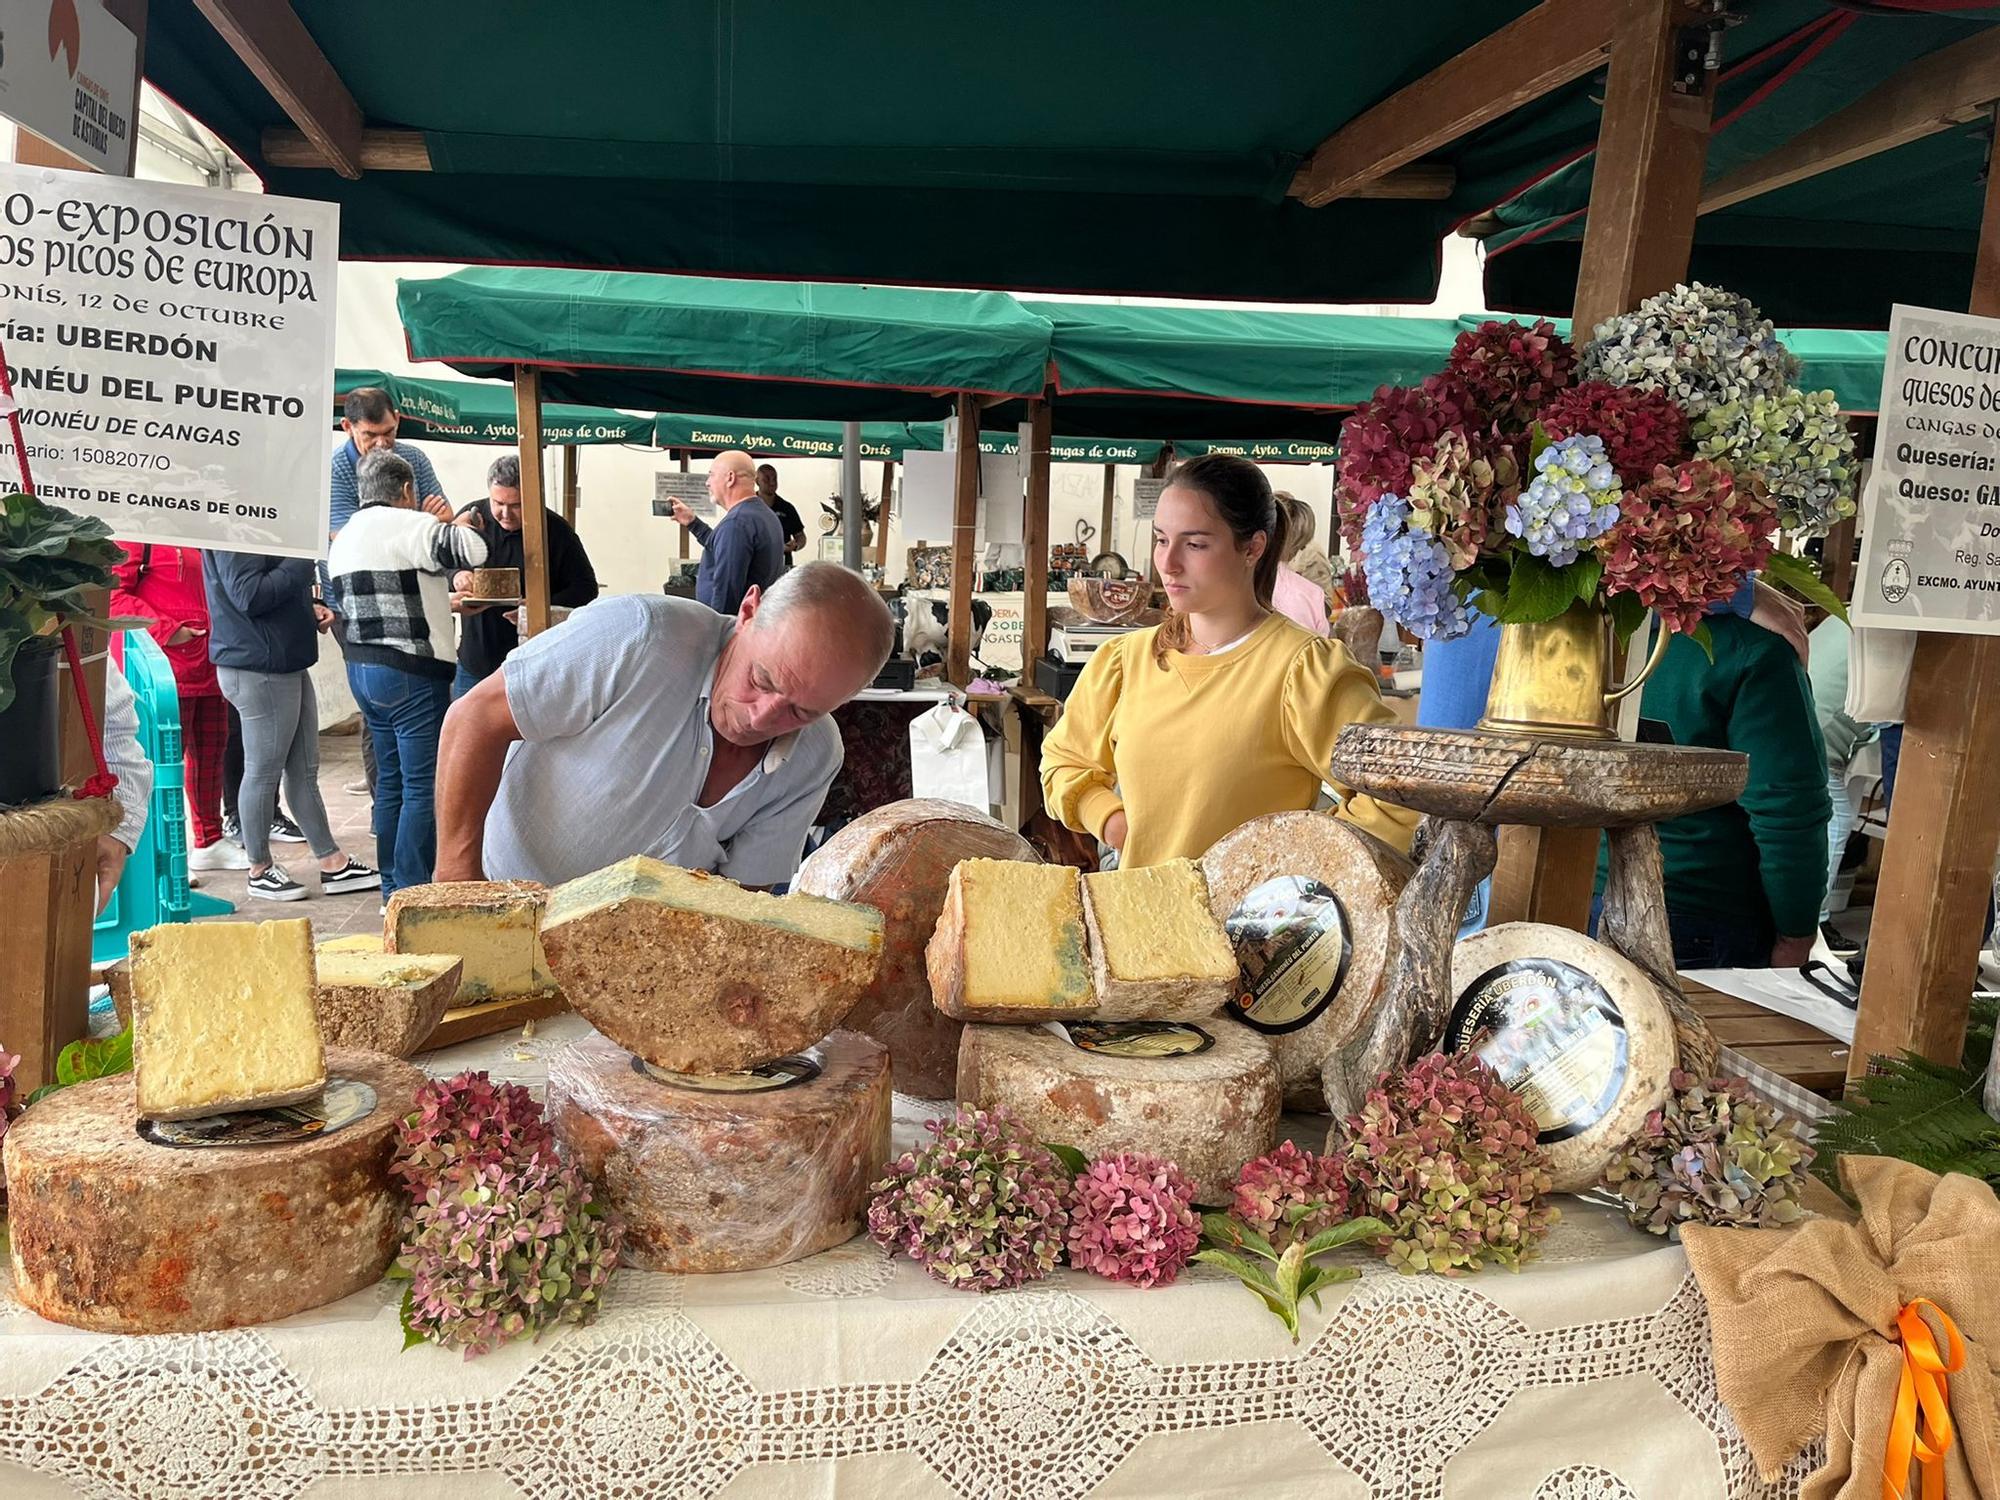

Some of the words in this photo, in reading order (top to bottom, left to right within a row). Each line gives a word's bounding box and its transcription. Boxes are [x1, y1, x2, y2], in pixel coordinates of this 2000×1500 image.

[43, 240, 135, 278] PICOS
[144, 245, 185, 285] DE
[194, 258, 317, 304] EUROPA
[78, 293, 102, 309] 12
[112, 293, 149, 314] DE
[159, 302, 285, 330] OCTUBRE
[57, 324, 217, 362] UBERDÓN
[101, 375, 163, 403] DEL
[175, 384, 304, 418] PUERTO
[105, 416, 138, 435] DE
[144, 421, 241, 446] CANGAS
[482, 423, 519, 440] Ayto.
[576, 425, 592, 438] de
[595, 426, 627, 439] Onís
[1906, 416, 1977, 436] CANGAS
[741, 434, 776, 449] Ayto.
[783, 436, 834, 455] Cangas
[860, 443, 891, 455] Onís
[1050, 447, 1085, 460] angas
[1088, 445, 1103, 457] de
[1106, 446, 1137, 458] Onís
[1251, 444, 1282, 458] Ayto.
[1288, 444, 1334, 460] Cangas
[1897, 443, 1995, 471] Quesería:
[1899, 478, 1970, 503] Queso:
[97, 490, 121, 503] DE
[127, 493, 201, 512] CANGAS
[207, 501, 230, 514] DE
[235, 504, 278, 519] ONIS
[1955, 550, 1981, 567] Reg.
[1917, 576, 1961, 589] EXCMO.
[1492, 970, 1558, 995] UBERDÓN
